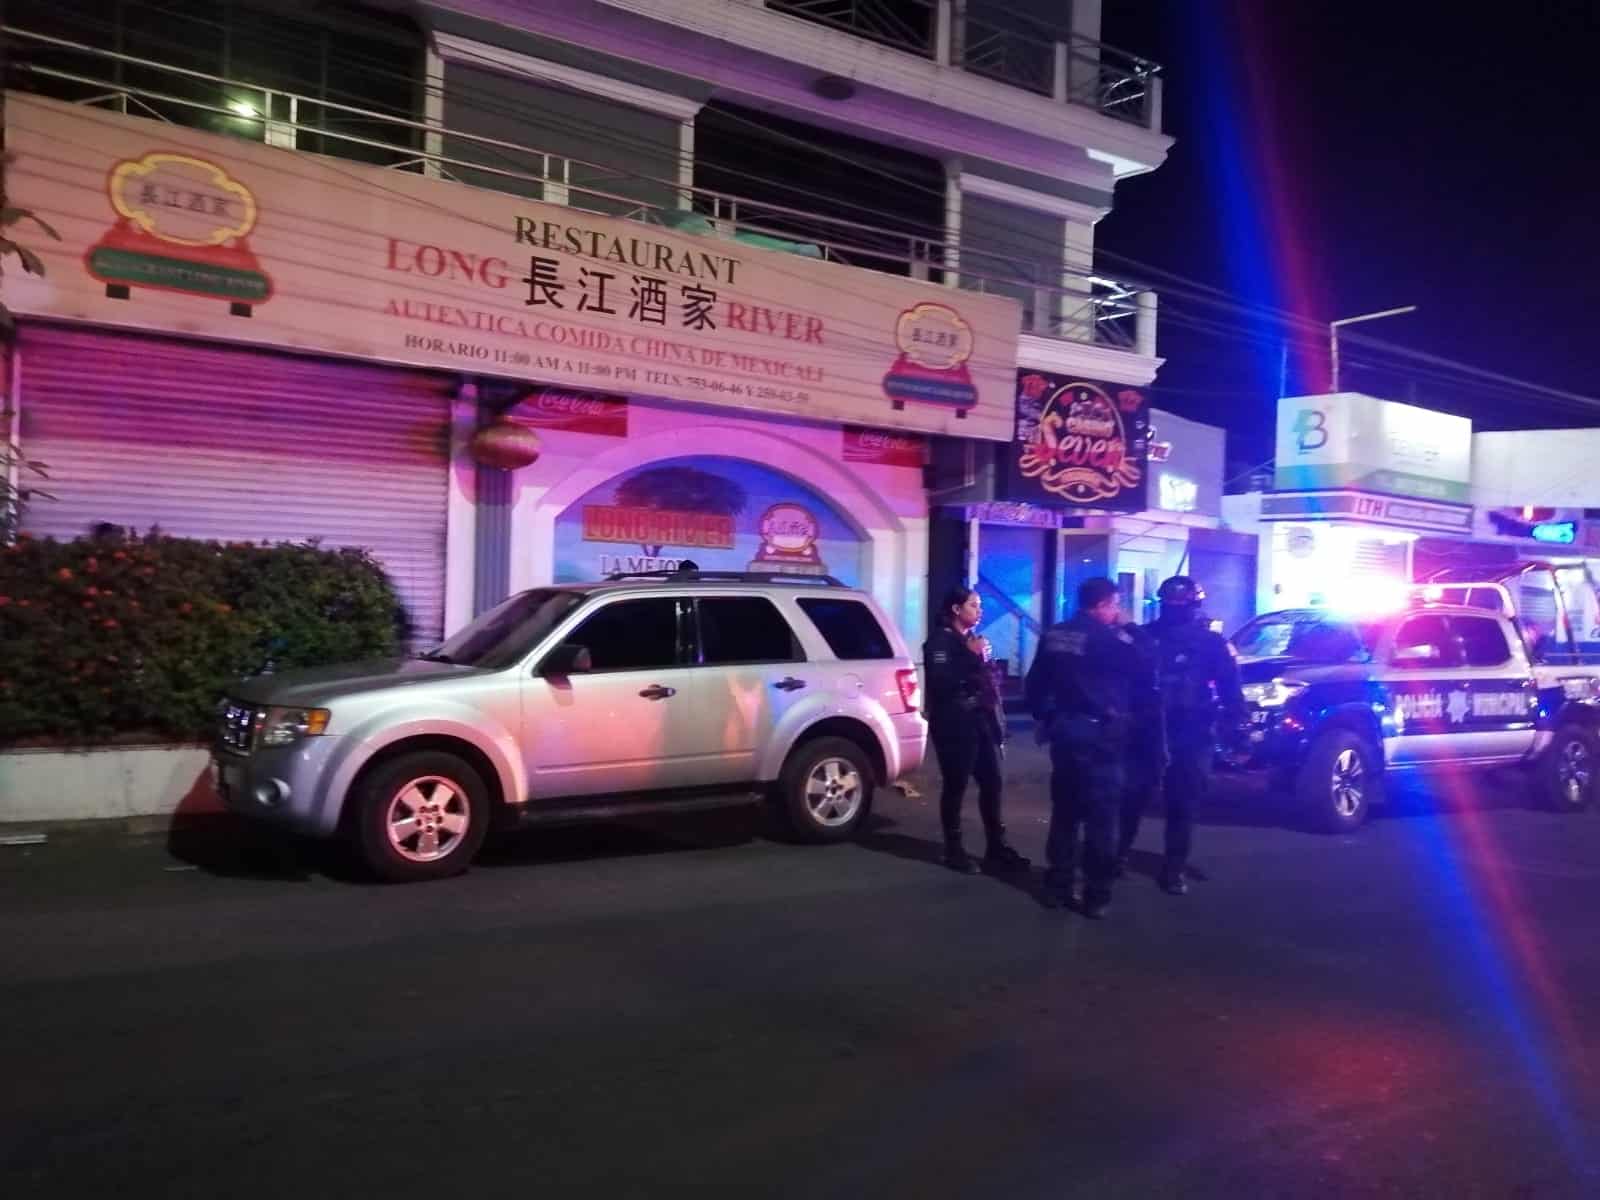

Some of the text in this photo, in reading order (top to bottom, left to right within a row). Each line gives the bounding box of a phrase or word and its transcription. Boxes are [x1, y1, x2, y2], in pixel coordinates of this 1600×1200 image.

[513, 215, 742, 285] RESTAURANT
[386, 238, 825, 345] LONG RIVER
[522, 256, 717, 331] 長江酒家
[383, 299, 825, 382] AUTENTICA COMIDA CHINA DE MEXICALI
[404, 334, 490, 360] HORARIO
[493, 349, 531, 367] 11:00
[535, 356, 559, 371] AM
[563, 358, 574, 374] A
[578, 361, 611, 377] 11:00
[615, 366, 638, 382] PM
[586, 507, 649, 541] LONG
[655, 511, 733, 546] RIVER
[601, 556, 622, 575] LA
